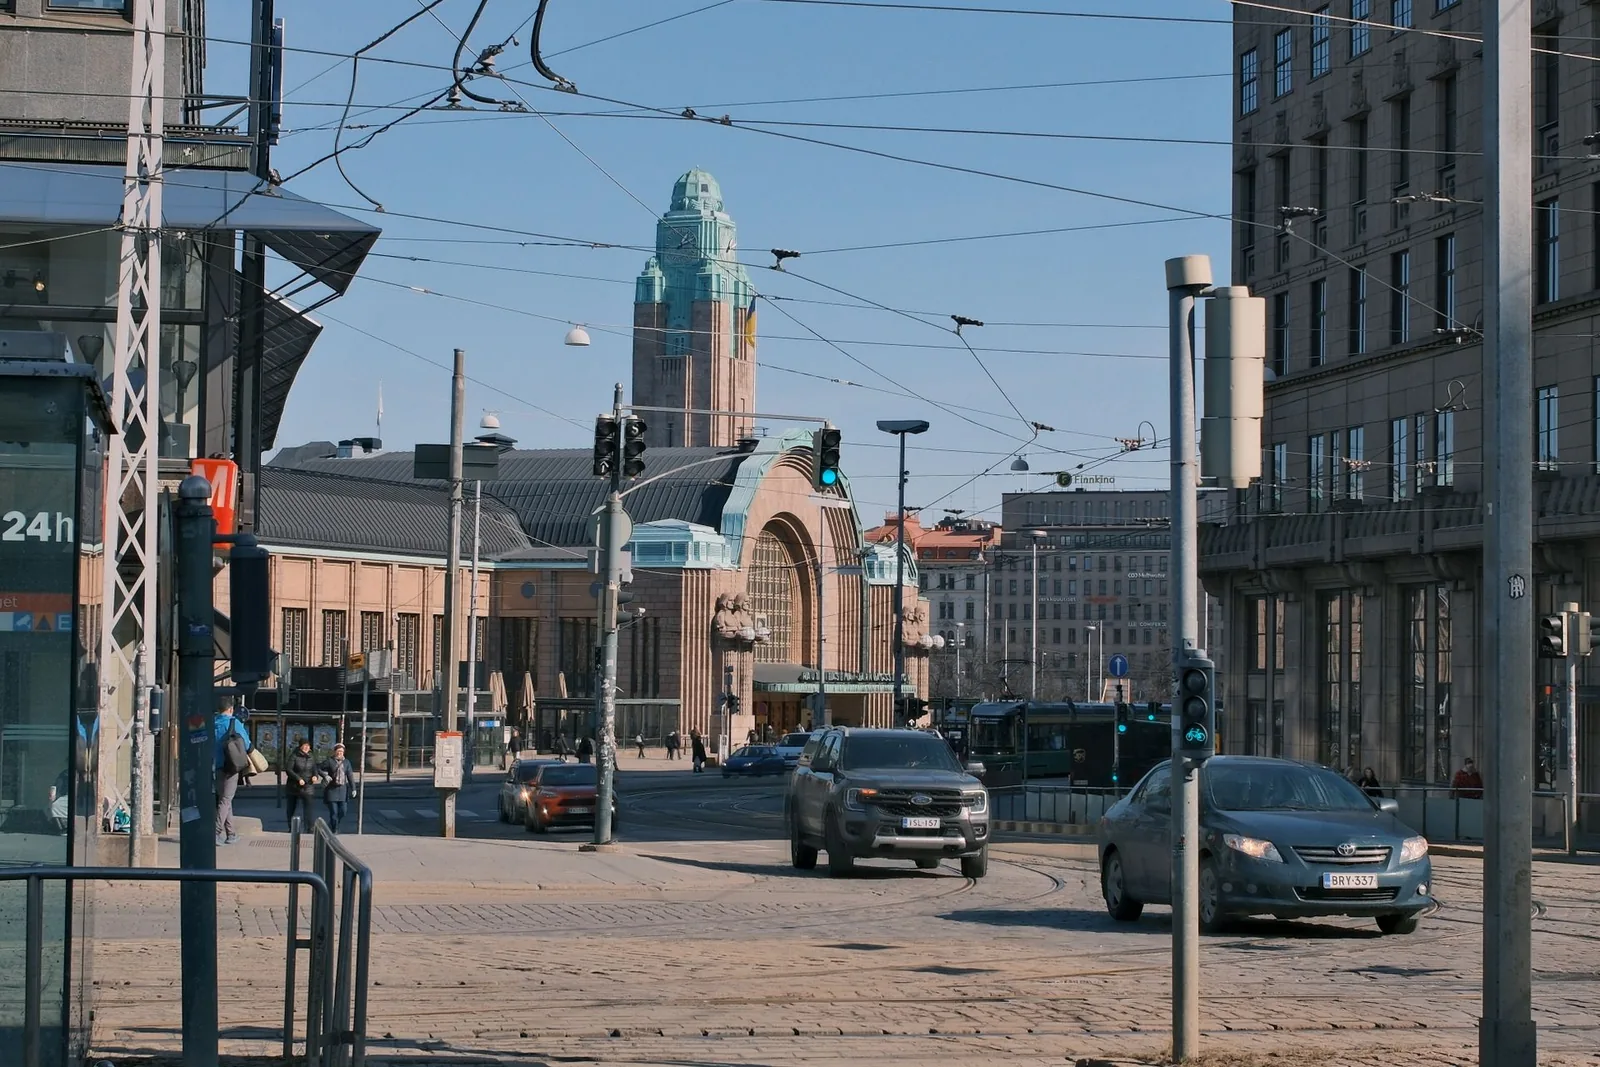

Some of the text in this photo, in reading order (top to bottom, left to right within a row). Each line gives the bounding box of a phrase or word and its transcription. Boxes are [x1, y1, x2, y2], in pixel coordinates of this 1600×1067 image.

[193, 463, 229, 508] M
[1074, 475, 1115, 484] Finnkino
[2, 510, 74, 543] 24h
[1332, 875, 1374, 886] BRY-337
